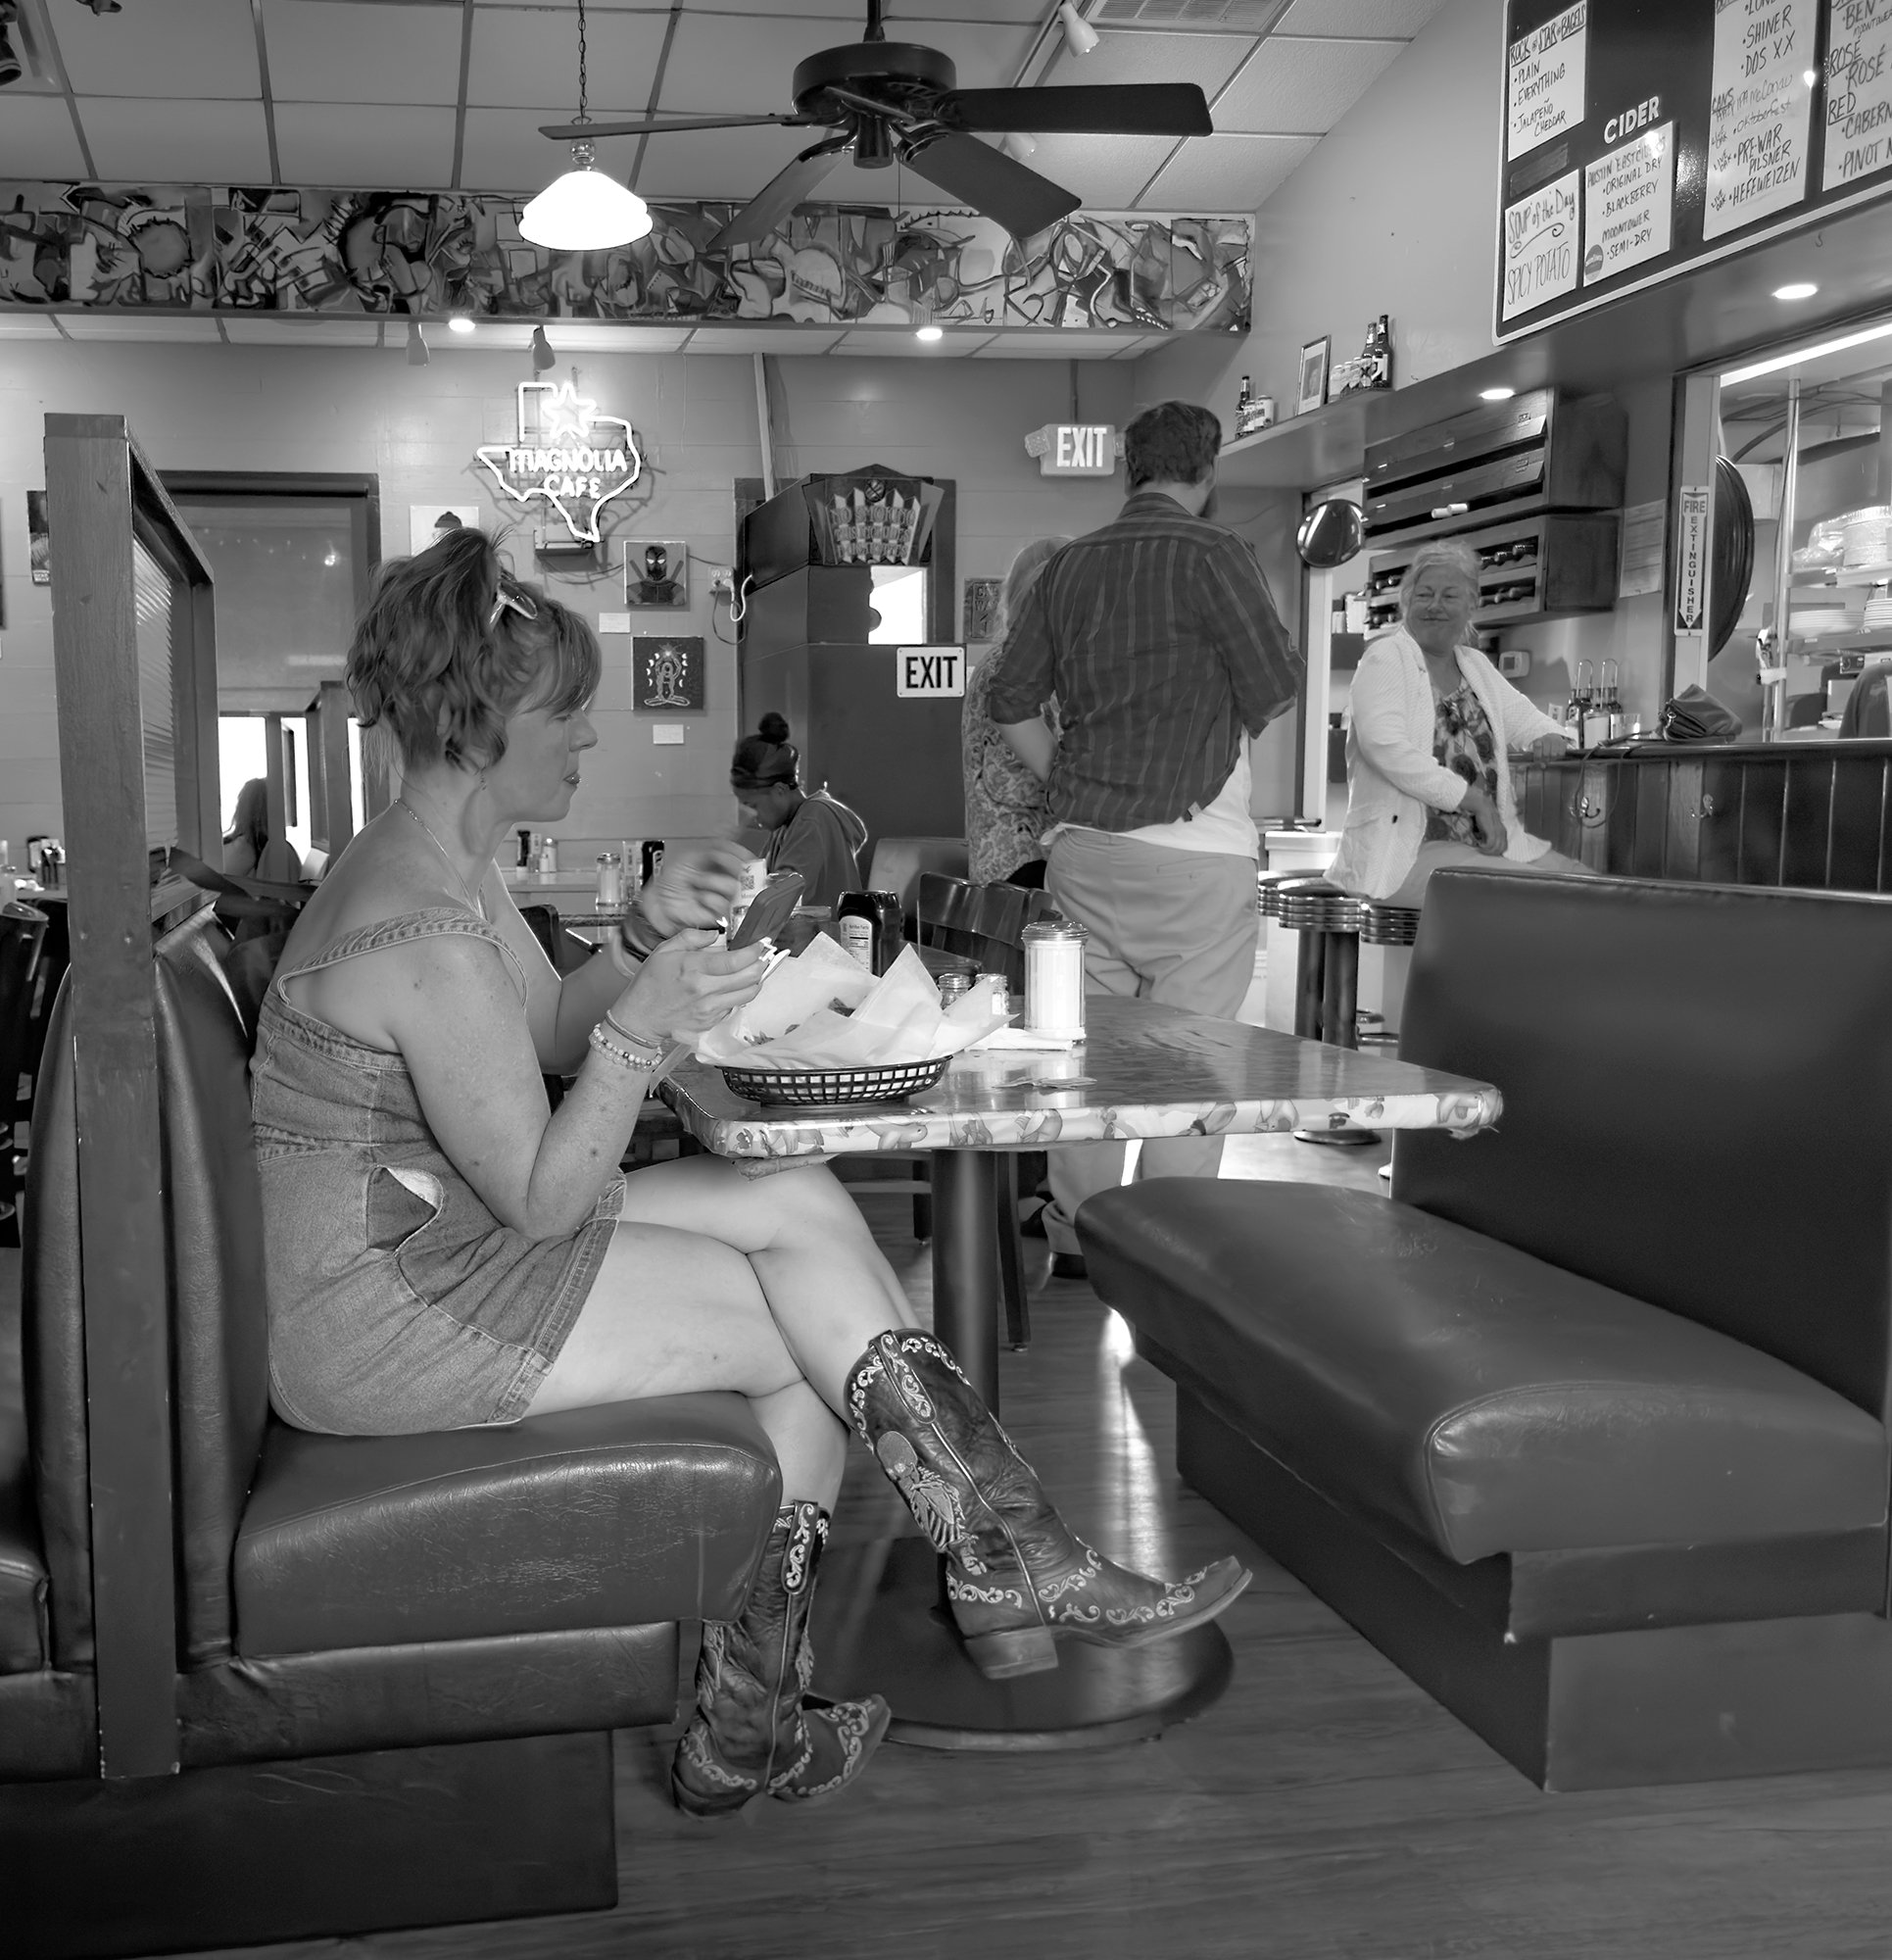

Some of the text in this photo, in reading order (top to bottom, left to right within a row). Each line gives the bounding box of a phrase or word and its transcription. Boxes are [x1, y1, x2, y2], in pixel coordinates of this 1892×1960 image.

[1510, 4, 1585, 66] ROCK STAR BAGELS
[1746, 4, 1792, 49] SHINER
[1518, 59, 1540, 84] PLAIN
[1745, 47, 1767, 77] DOS
[1847, 43, 1886, 91] ROSÉ
[1518, 62, 1566, 106] EVERYTHING
[1517, 97, 1554, 134] JALAPEÑO
[1533, 110, 1567, 137] CHEDDAR
[1603, 95, 1660, 145] CIDER
[1828, 91, 1856, 125] RED
[1737, 122, 1782, 167] PRE-WAR
[1748, 138, 1792, 176] PILSNER
[1843, 138, 1883, 178] PINOT
[1587, 159, 1613, 188] AUSTIN
[1607, 155, 1663, 195] ORIGINAL DRY
[1733, 156, 1801, 204] HEFEWEIZEN
[1509, 206, 1531, 244] SOUP
[1555, 188, 1576, 220] Day
[1607, 178, 1660, 219] BLACKBERRY
[1602, 209, 1650, 244] MOONTOWER
[1610, 227, 1653, 261] SEMI-DRY
[1508, 241, 1571, 306] SPICY POTATO
[509, 447, 628, 473] MAGNOLIA
[1056, 426, 1107, 467] EXIT
[1683, 500, 1706, 514] FIRE
[1686, 515, 1698, 622] EXTINGUISHER
[905, 656, 957, 689] EXIT
